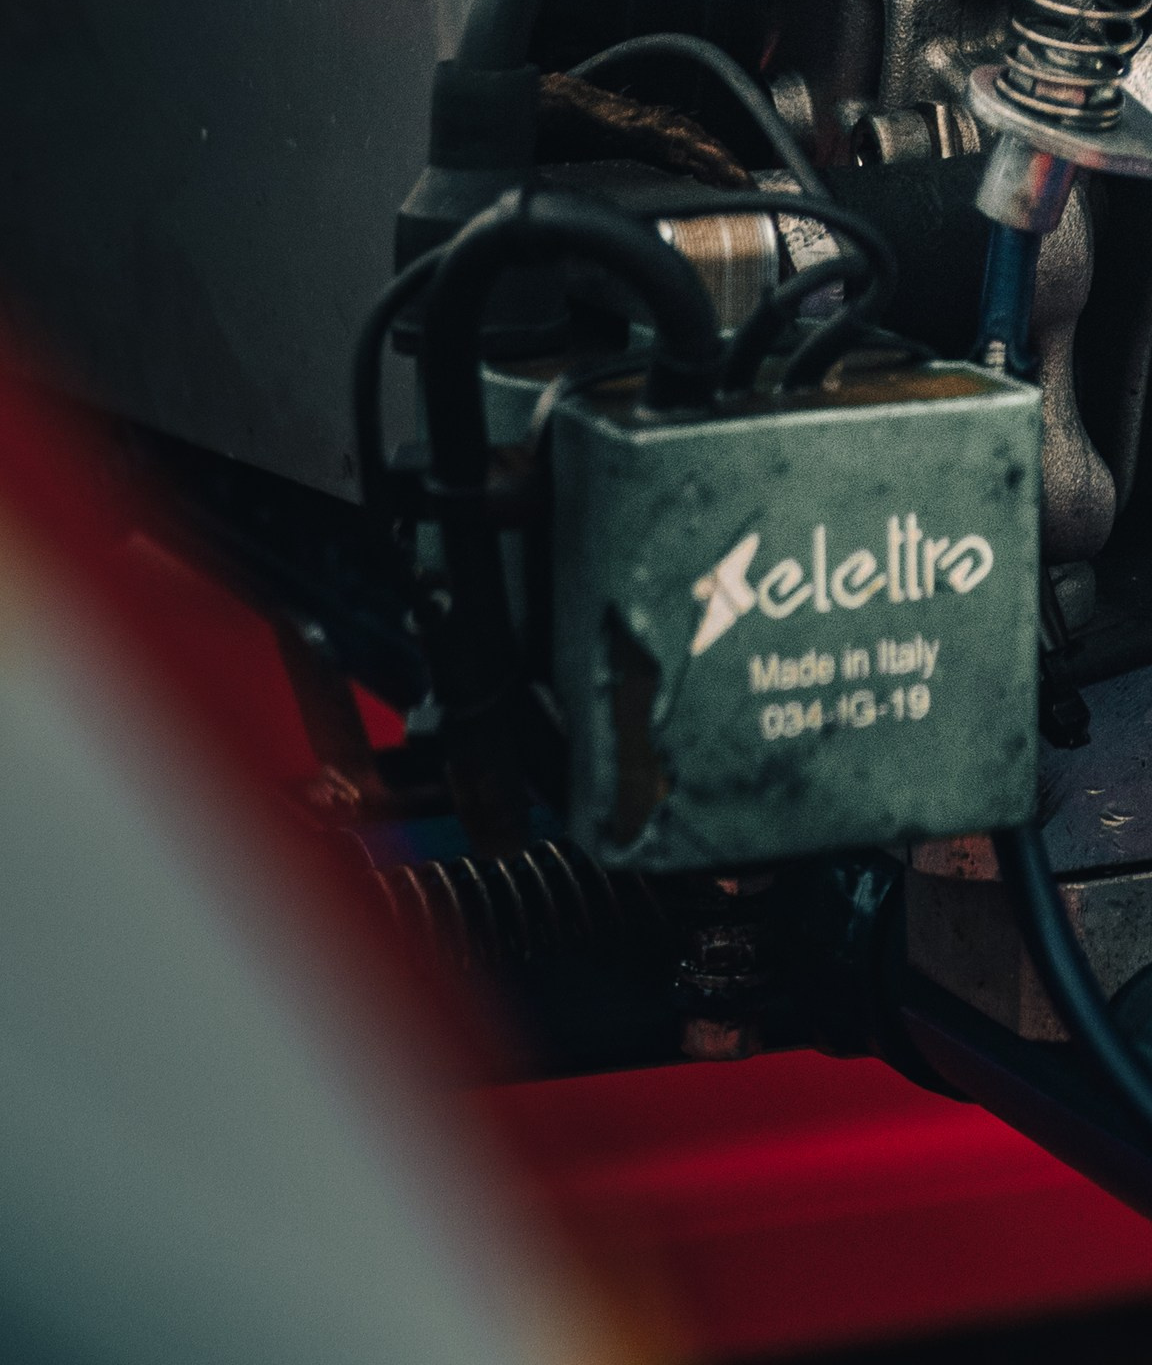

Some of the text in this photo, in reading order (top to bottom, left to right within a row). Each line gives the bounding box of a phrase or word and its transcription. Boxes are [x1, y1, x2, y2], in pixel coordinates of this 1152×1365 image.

[752, 634, 941, 693] Made in Italy
